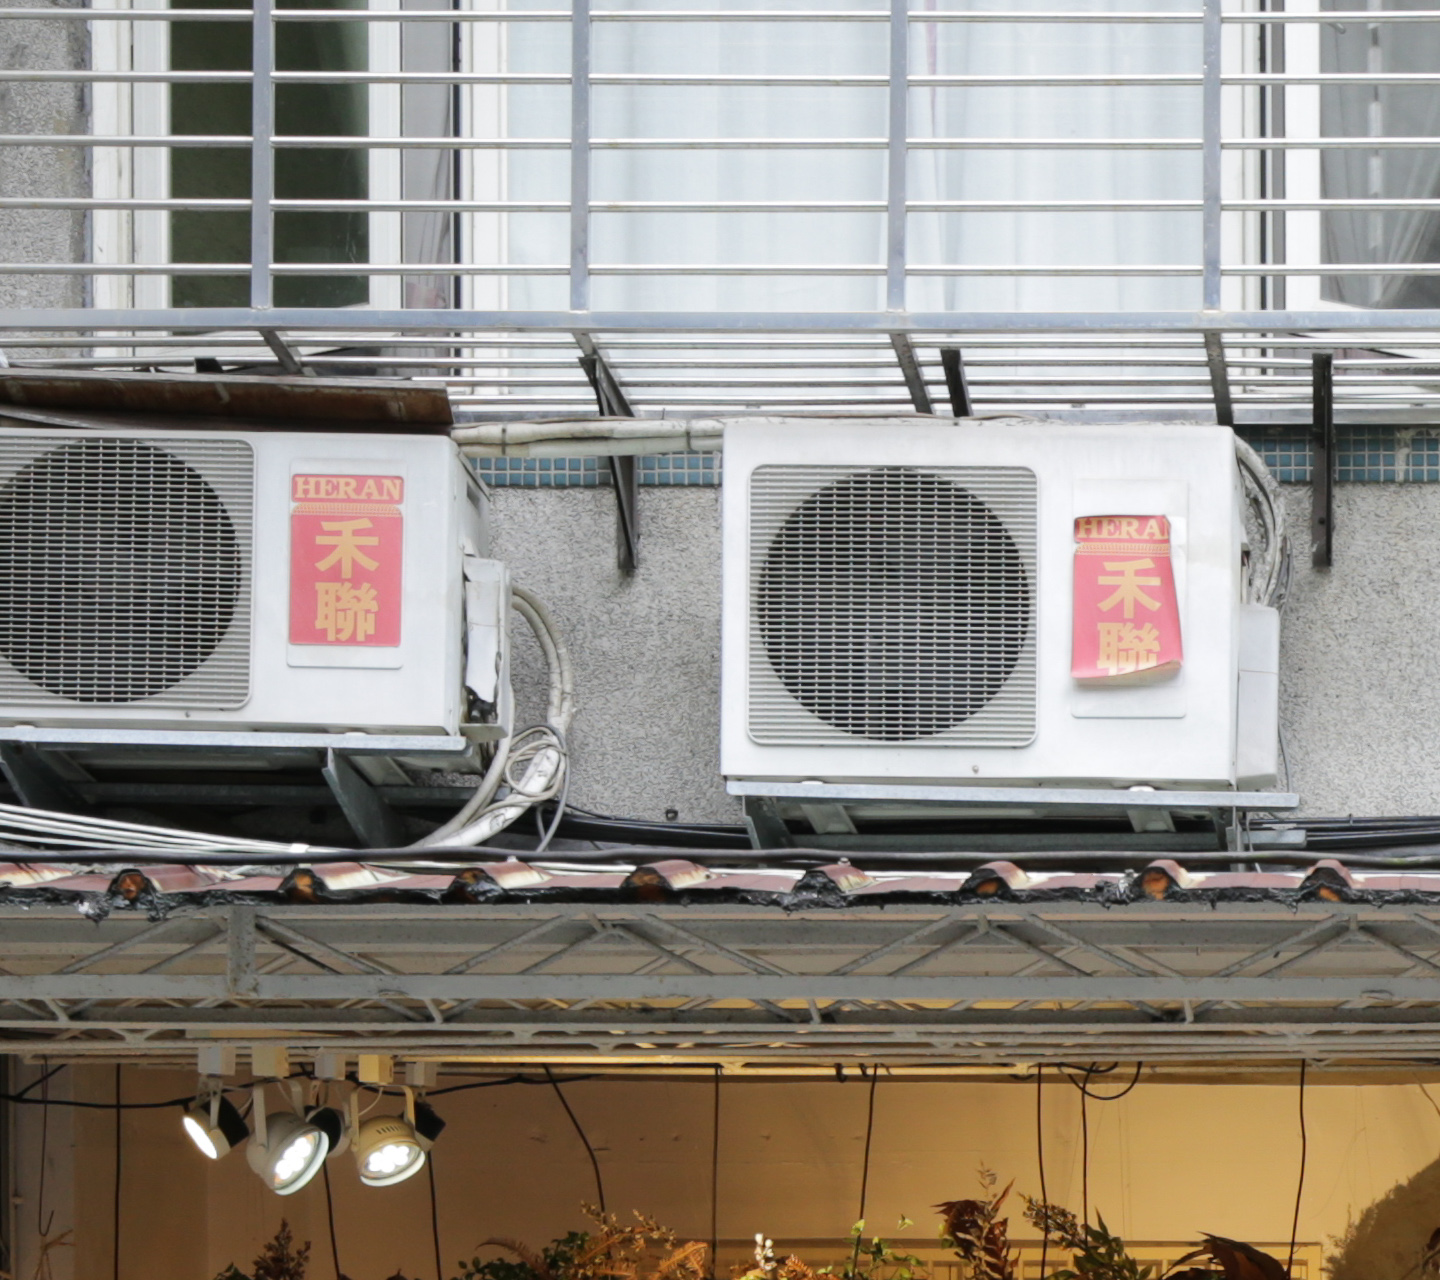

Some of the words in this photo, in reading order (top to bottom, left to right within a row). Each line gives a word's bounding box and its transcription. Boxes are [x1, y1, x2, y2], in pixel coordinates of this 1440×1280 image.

[295, 476, 402, 500] HERAN
[315, 517, 380, 642] 禾聯
[1097, 558, 1163, 676] 禾聯
